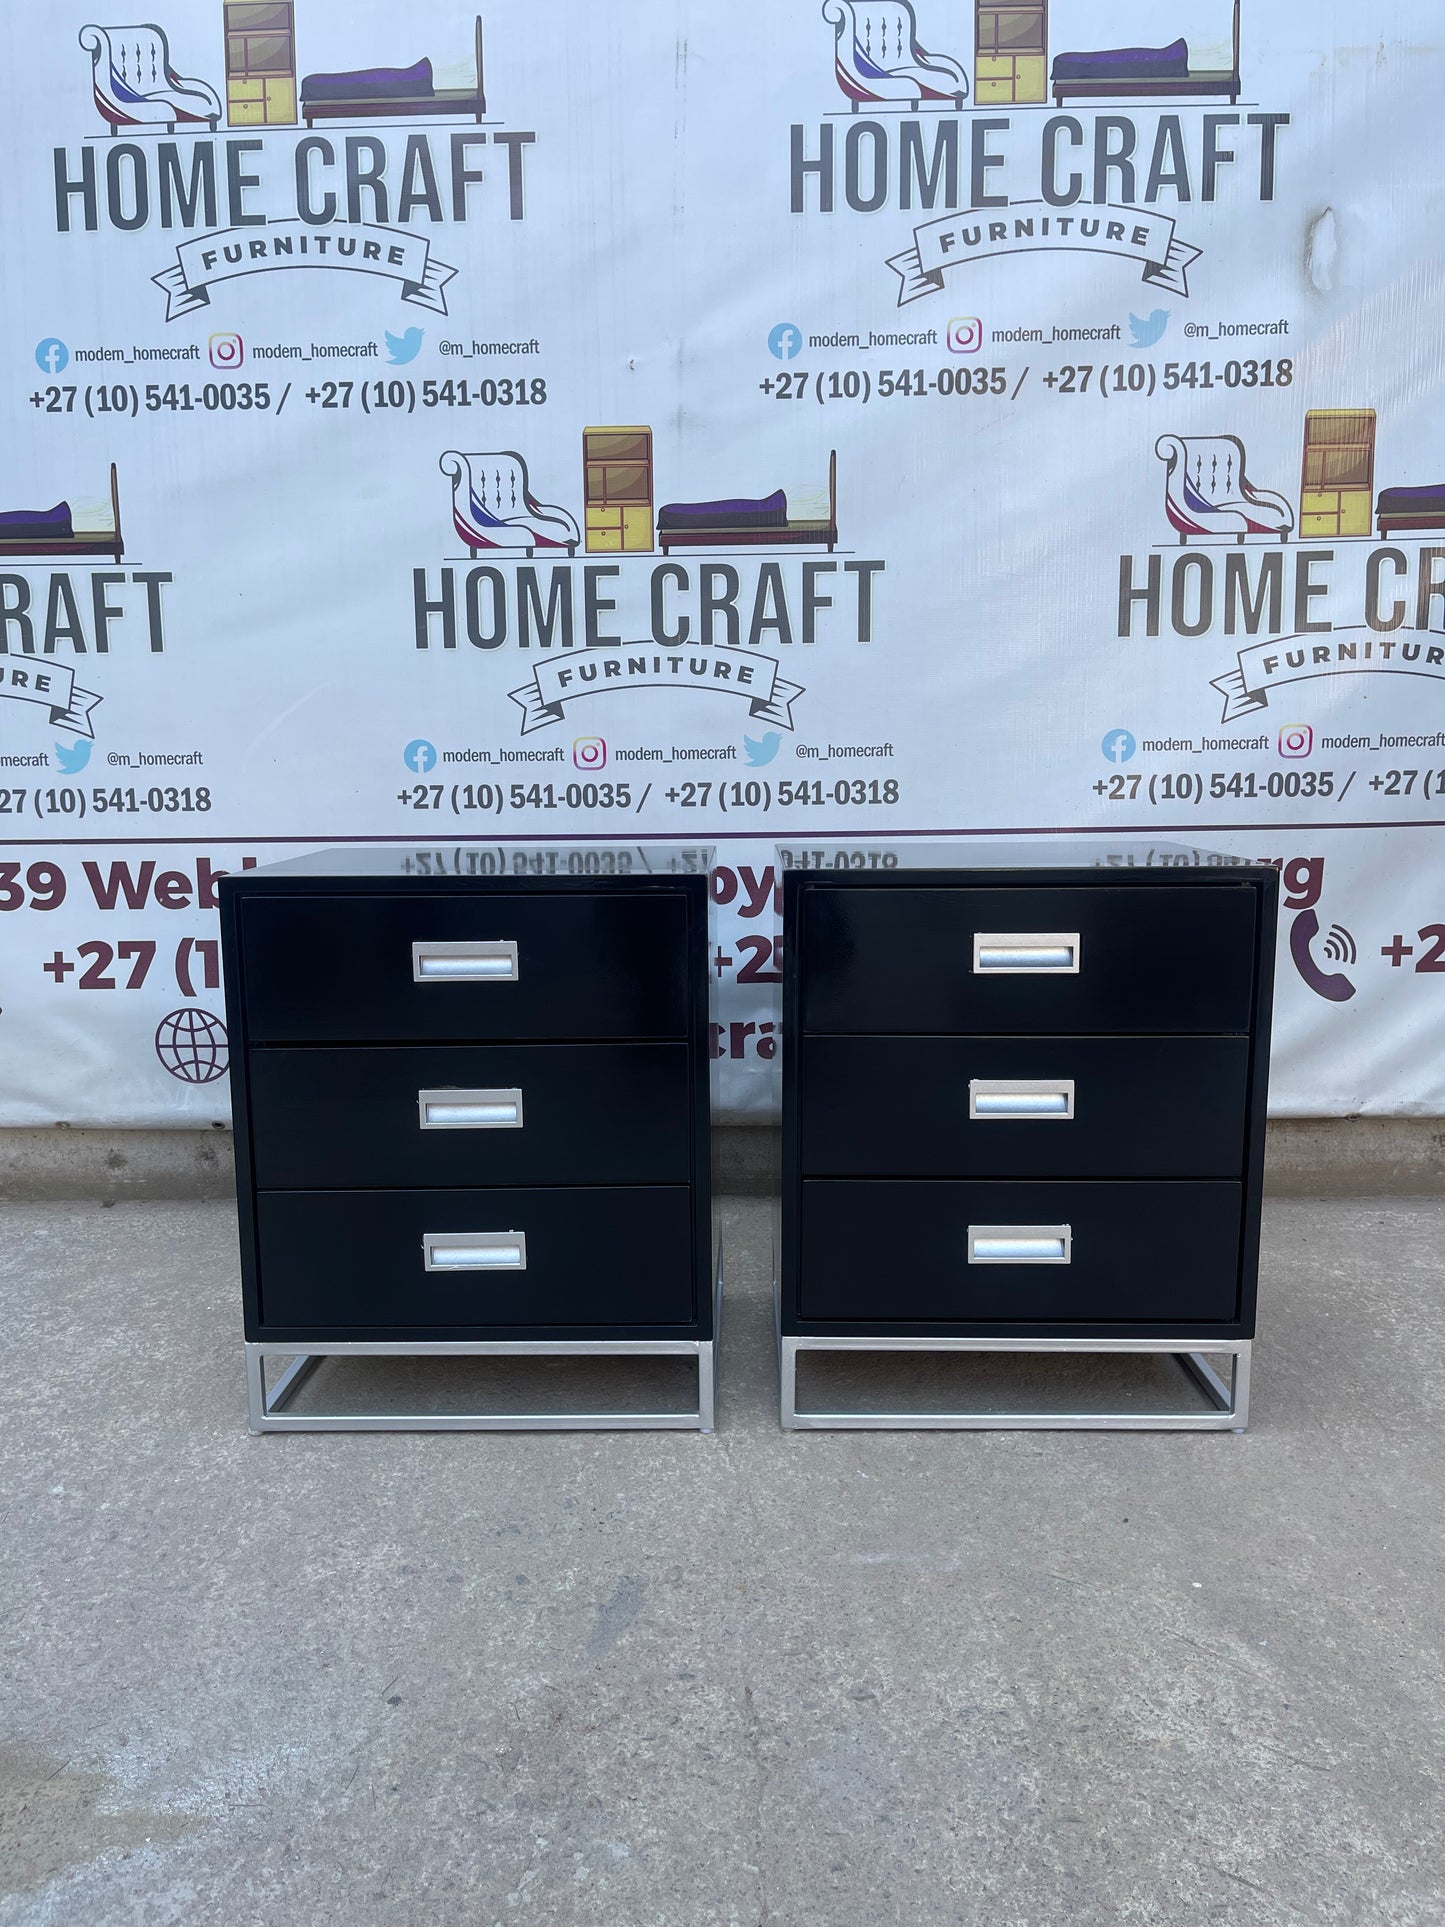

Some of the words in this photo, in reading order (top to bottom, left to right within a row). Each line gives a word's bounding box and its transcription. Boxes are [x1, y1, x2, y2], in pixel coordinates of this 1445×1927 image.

[53, 138, 267, 233] HOME
[295, 130, 537, 226] CRAFT
[790, 117, 1011, 214] HOME
[1040, 112, 1291, 208] CRAFT
[201, 235, 406, 270] FURNITURE
[938, 217, 1151, 254] FURNITURE
[438, 338, 540, 359] @m_homecraft
[1183, 318, 1289, 340] @m_homecraft
[29, 385, 78, 413] +27
[84, 384, 139, 418] (10)
[145, 382, 271, 412] 541-0035
[305, 381, 354, 409] +27
[361, 380, 416, 415] (10)
[422, 377, 547, 408] 541-0318
[759, 372, 809, 400] +27
[815, 370, 871, 405] (10)
[877, 366, 1007, 398] 541-0035
[1042, 365, 1094, 393] +27
[1099, 363, 1156, 399] (10)
[1162, 358, 1293, 390] 541-0318
[0, 571, 173, 654] RAFT
[412, 564, 622, 650] HOME
[650, 559, 886, 648] CRAFT
[1117, 550, 1335, 637] HOME
[557, 656, 756, 688] FURNITURE
[107, 750, 204, 769] @m_homecraft
[795, 742, 894, 761] @m_homecraft
[34, 788, 86, 819] (10)
[92, 786, 212, 813] 541-0318
[397, 784, 444, 810] +27
[451, 784, 504, 815] (10)
[509, 783, 632, 809] 541-0035
[664, 781, 713, 807] +27
[718, 781, 772, 813] (10)
[777, 778, 900, 806] 541-0318
[1092, 774, 1142, 800] +27
[1148, 773, 1203, 806] (10)
[1209, 771, 1334, 799] 541-0035
[1368, 769, 1419, 796] +27
[0, 861, 67, 911] 39
[81, 857, 257, 910] Web
[43, 940, 157, 989] +27
[1381, 923, 1445, 973] +2
